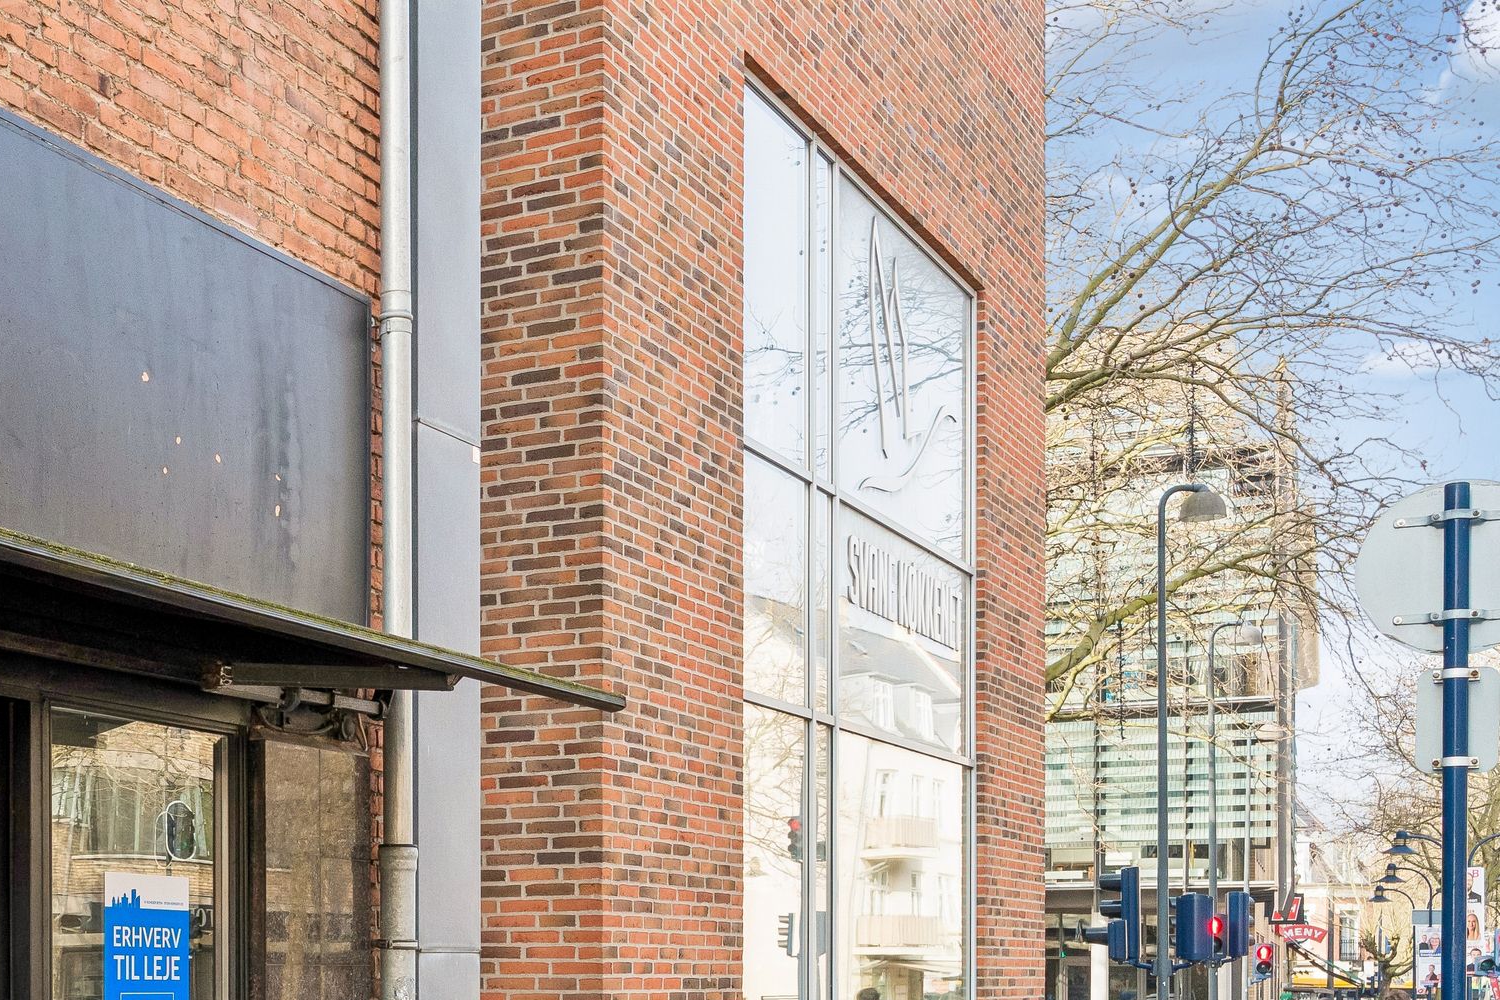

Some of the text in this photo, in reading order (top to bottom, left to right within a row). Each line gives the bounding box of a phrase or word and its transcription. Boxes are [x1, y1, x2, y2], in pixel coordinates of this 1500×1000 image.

[847, 534, 962, 652] SVANE KØKKENET
[113, 925, 182, 948] ERHVERV
[1283, 927, 1322, 938] MENY
[113, 955, 181, 981] TIL LEJE
